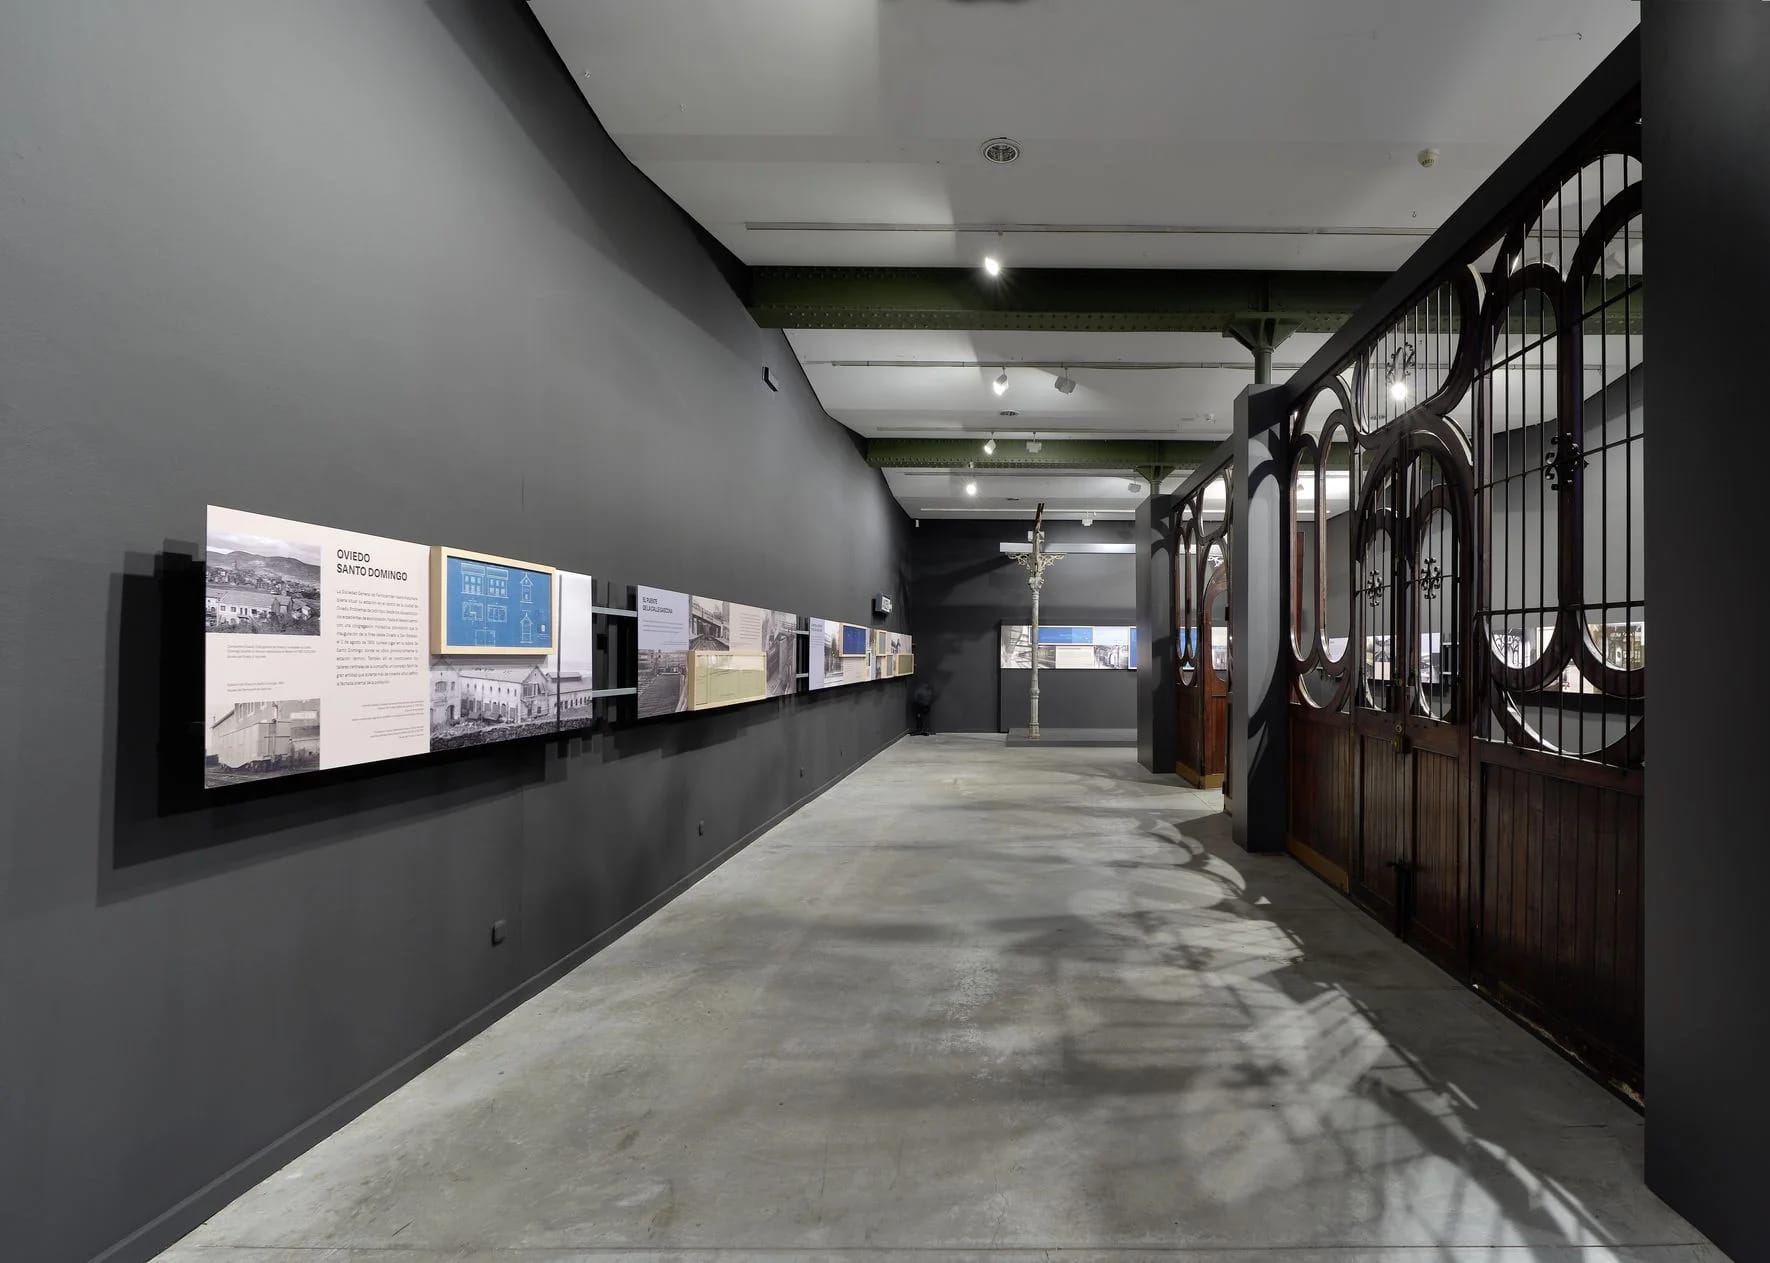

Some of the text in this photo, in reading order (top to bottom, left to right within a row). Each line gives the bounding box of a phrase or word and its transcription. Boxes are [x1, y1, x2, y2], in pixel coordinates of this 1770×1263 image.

[337, 549, 370, 562] OVIEDO
[337, 563, 407, 581] SANTO DOMINGO
